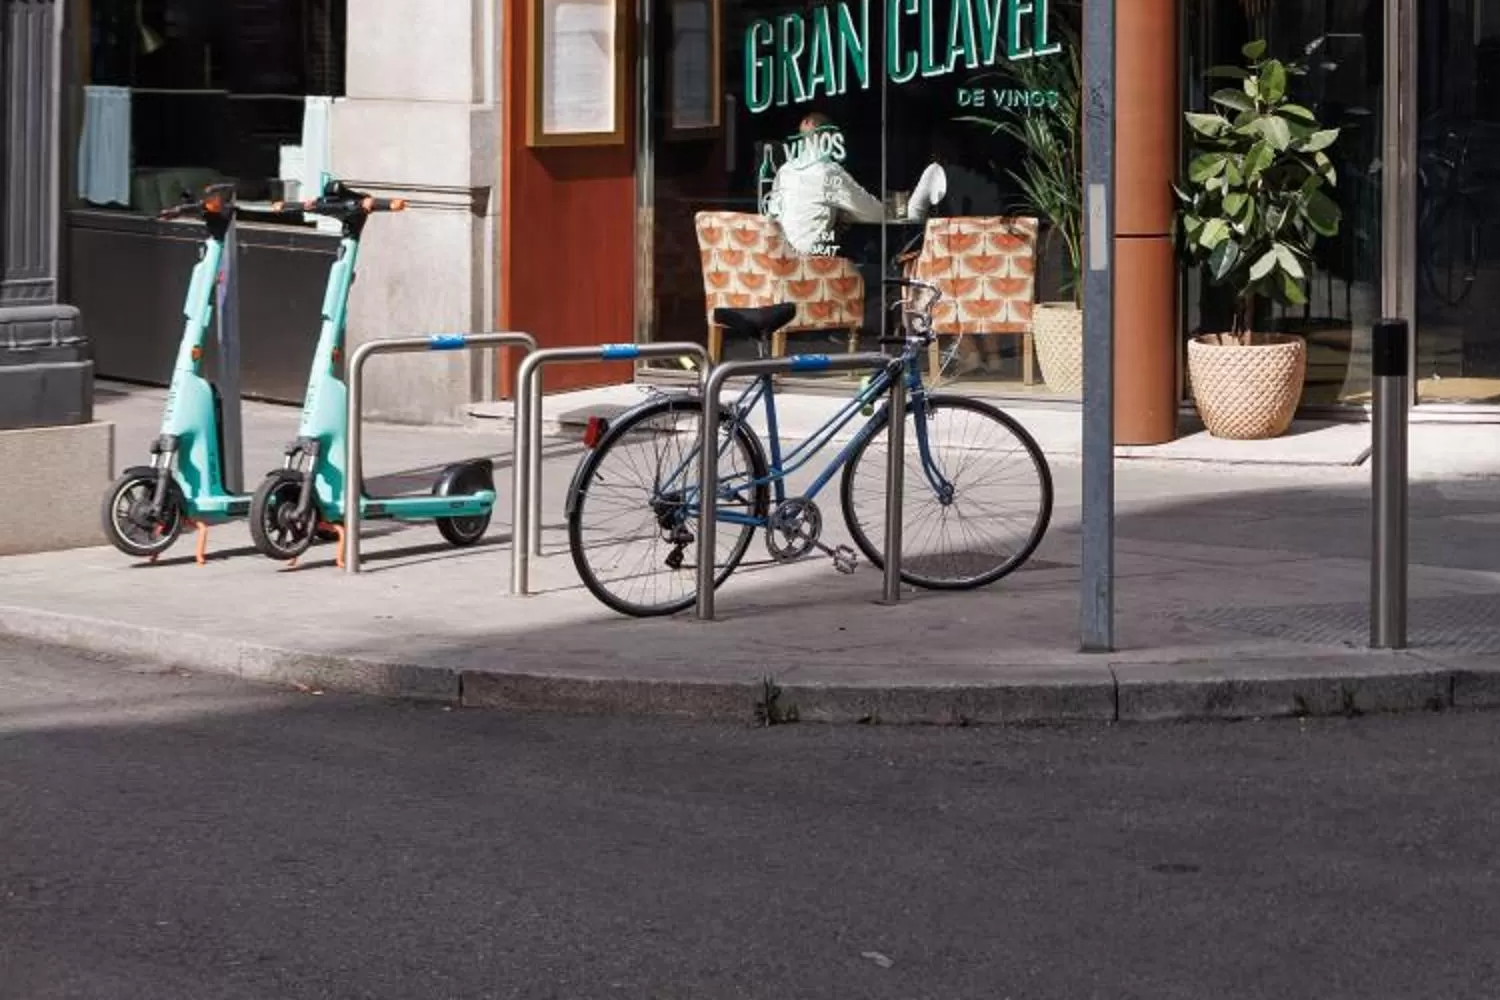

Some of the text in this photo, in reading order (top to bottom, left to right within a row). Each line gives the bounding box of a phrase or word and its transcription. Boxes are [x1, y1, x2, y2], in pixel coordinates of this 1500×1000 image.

[957, 88, 1060, 111] DE VINOS
[783, 131, 847, 165] VINOS
